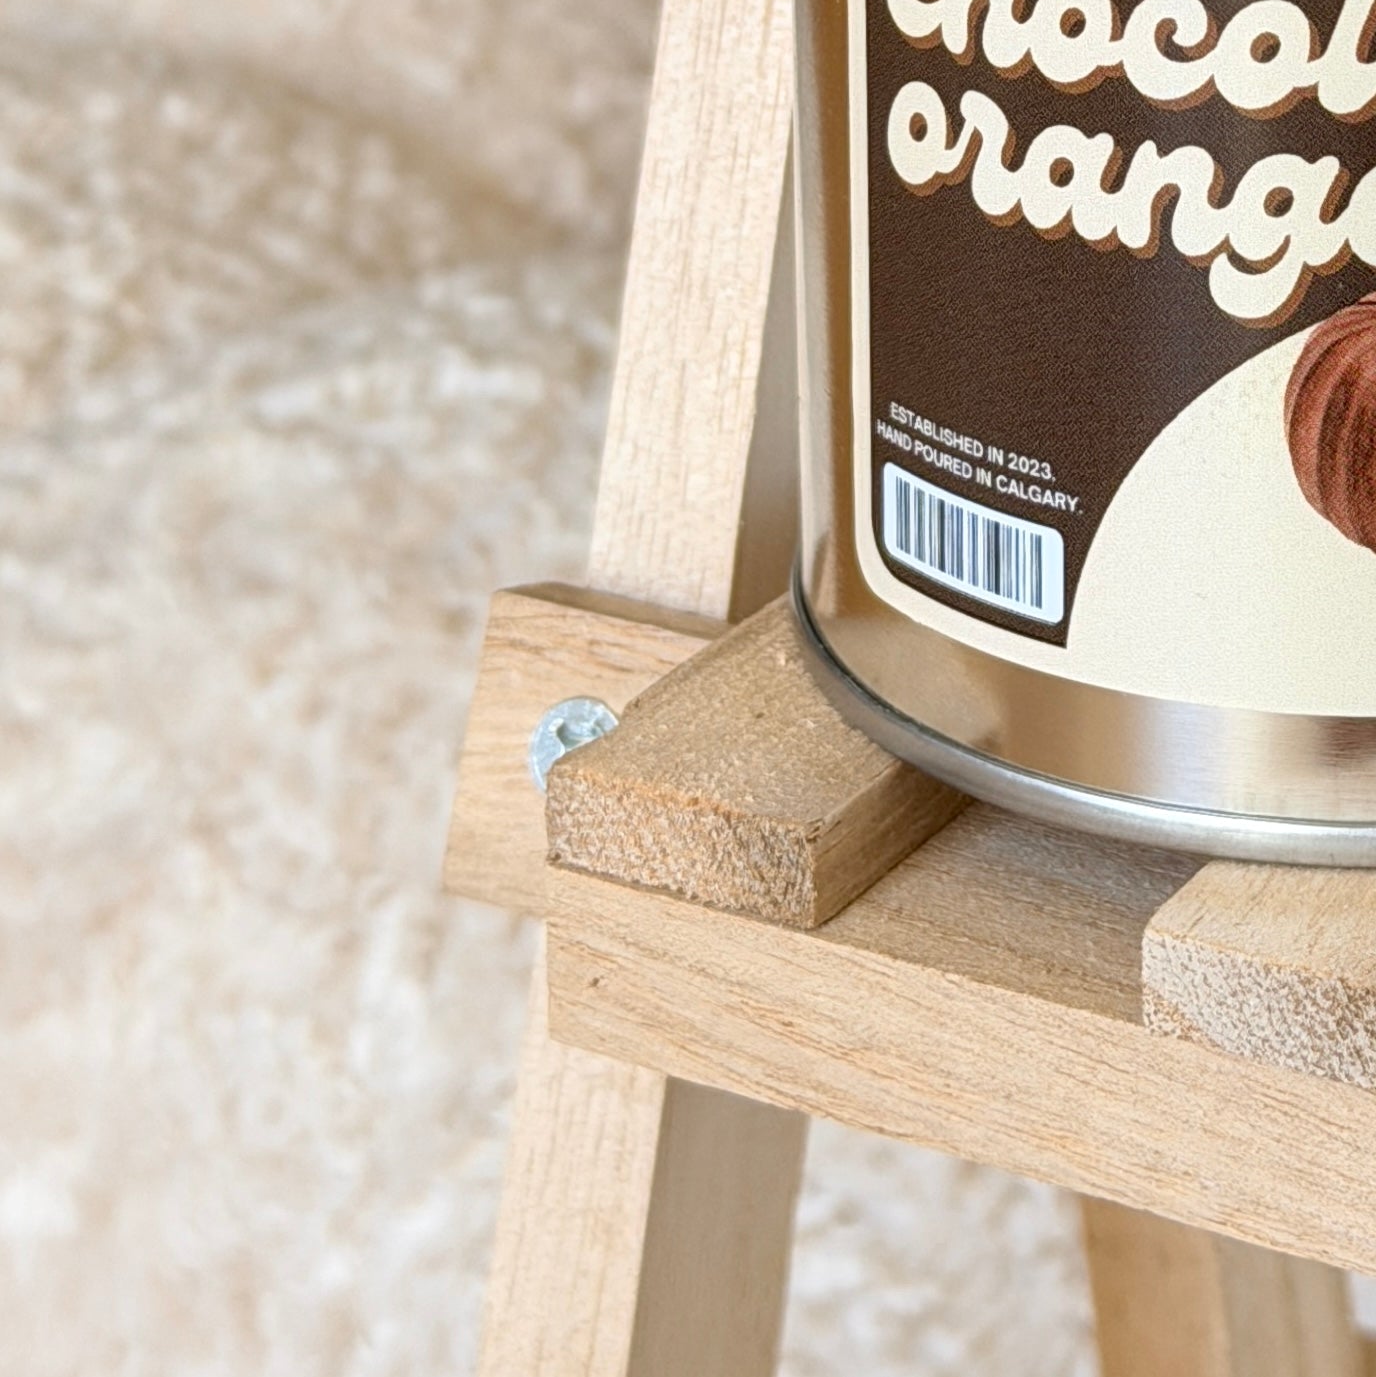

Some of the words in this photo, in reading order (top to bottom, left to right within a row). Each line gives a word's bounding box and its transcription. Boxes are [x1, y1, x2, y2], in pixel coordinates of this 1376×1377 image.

[876, 419, 912, 452] HAND
[914, 440, 972, 479] POURED
[976, 467, 992, 487] IN
[996, 475, 1084, 515] CALGARY.
[890, 402, 983, 457] ESTABLISHED
[988, 445, 1003, 466] IN
